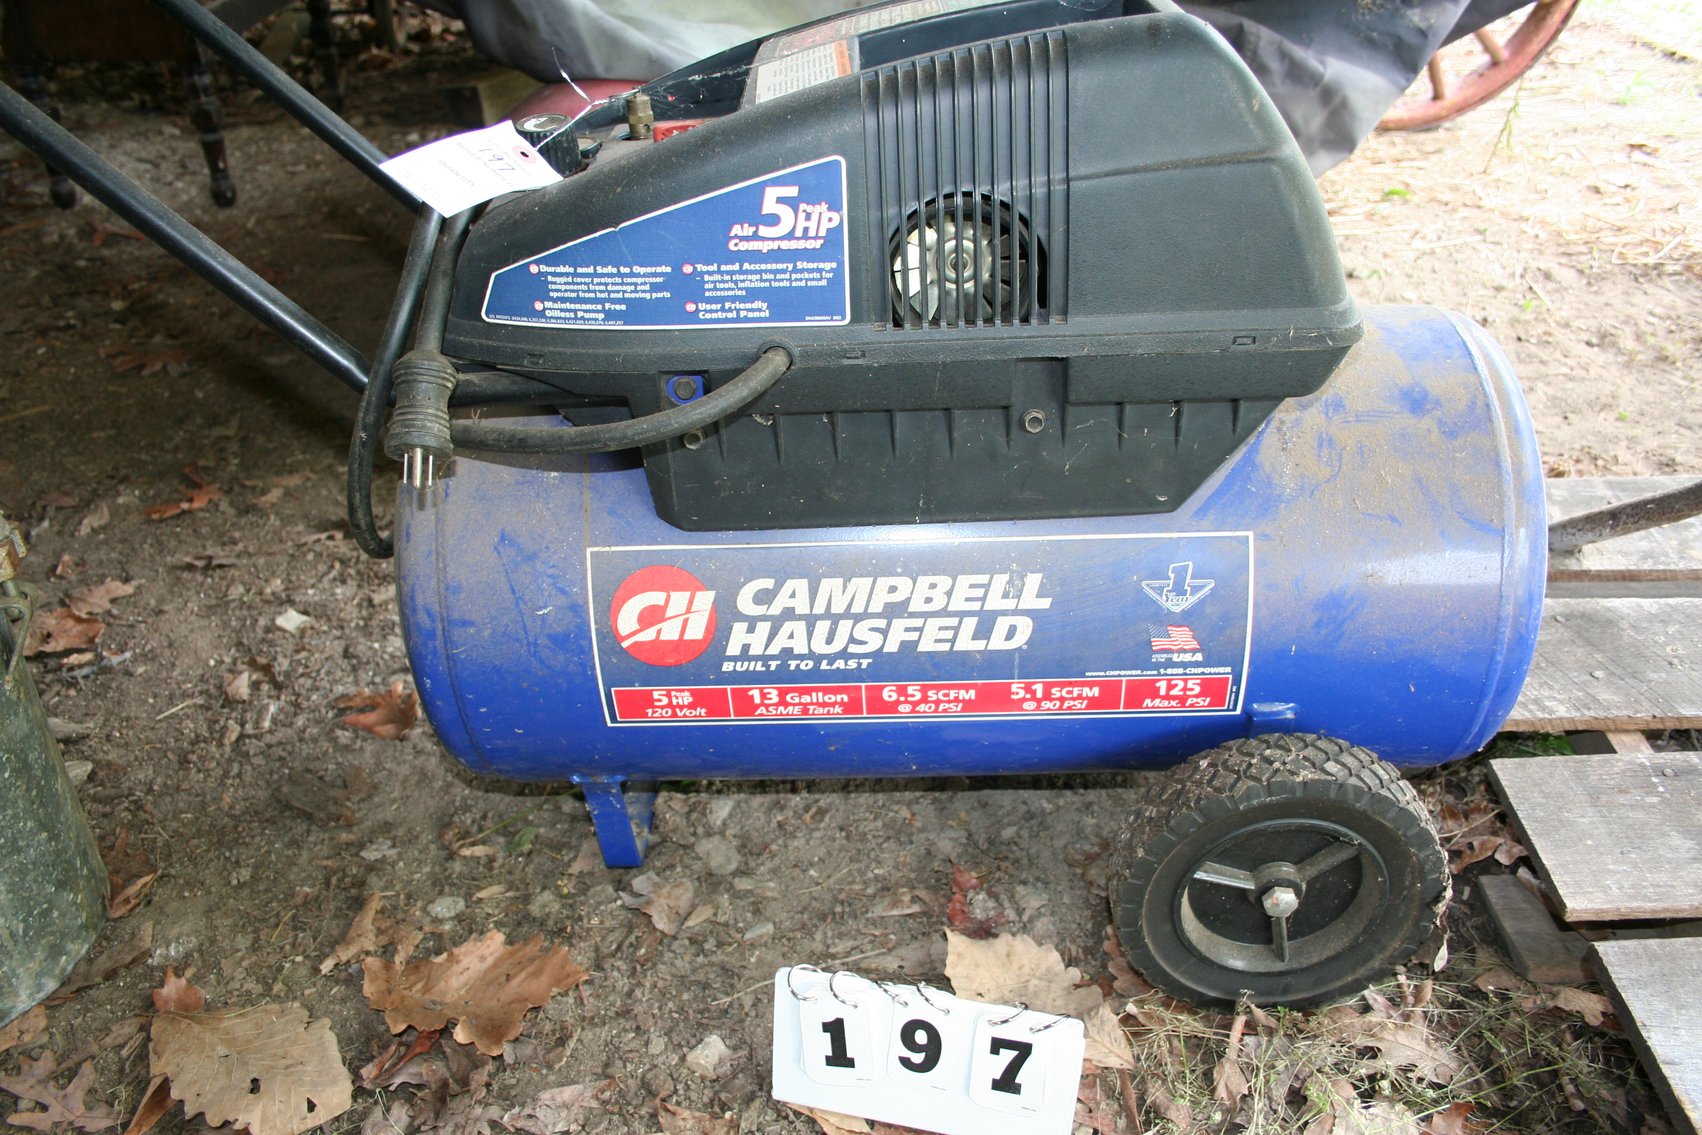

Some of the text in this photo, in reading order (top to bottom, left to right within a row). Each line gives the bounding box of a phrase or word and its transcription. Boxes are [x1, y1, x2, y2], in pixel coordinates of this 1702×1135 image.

[729, 185, 841, 238] Air 5 Peak HP
[728, 238, 824, 253] Compressor
[539, 265, 574, 273] Durable
[577, 265, 593, 273] and
[596, 265, 617, 274] Safe
[619, 265, 630, 274] to
[632, 265, 672, 275] Operate
[695, 263, 717, 272] Tool
[720, 262, 740, 271] and
[742, 262, 794, 272] Accessory
[796, 261, 837, 271] Storage
[547, 276, 572, 284] Rugged
[594, 276, 622, 284] protects
[623, 277, 664, 285] compressor
[732, 273, 761, 282] storage
[762, 272, 774, 280] bin
[775, 272, 790, 280] and
[791, 272, 821, 280] pockets
[822, 271, 834, 279] for
[548, 283, 650, 292] components from damage and
[716, 281, 737, 289] tools,
[738, 280, 770, 288] inflation
[807, 279, 827, 287] small
[579, 291, 595, 299] from
[597, 291, 608, 299] hot
[610, 291, 623, 299] and
[624, 291, 650, 299] moving
[652, 291, 671, 299] parts
[704, 289, 746, 297] accessories
[544, 301, 603, 311] Maintenance
[605, 302, 627, 311] Free
[724, 301, 768, 311] Friendly
[545, 310, 605, 320] Oilless Pump
[698, 310, 770, 319] Control Panel
[736, 573, 1053, 616] CAMPBELL
[725, 615, 1033, 656] HAUSFELD
[1172, 652, 1203, 662] USA
[721, 659, 873, 672] BUILT TO LAST
[1085, 666, 1232, 677] www.CHPOWER.com 1-888-CHPOWER
[1010, 683, 1100, 699] 5.1 SCFM
[1155, 679, 1201, 696] 125
[652, 690, 669, 706] 5
[672, 696, 693, 706] HP
[747, 688, 848, 704] 13 Gallon
[882, 686, 976, 702] 6.5 SCFM
[897, 702, 963, 713] @ 40 PSI
[1022, 700, 1088, 711] @ 90 PSI
[1142, 697, 1211, 708] Max. PSI
[645, 706, 708, 718] 120 Volt
[754, 704, 843, 716] ASME Tank
